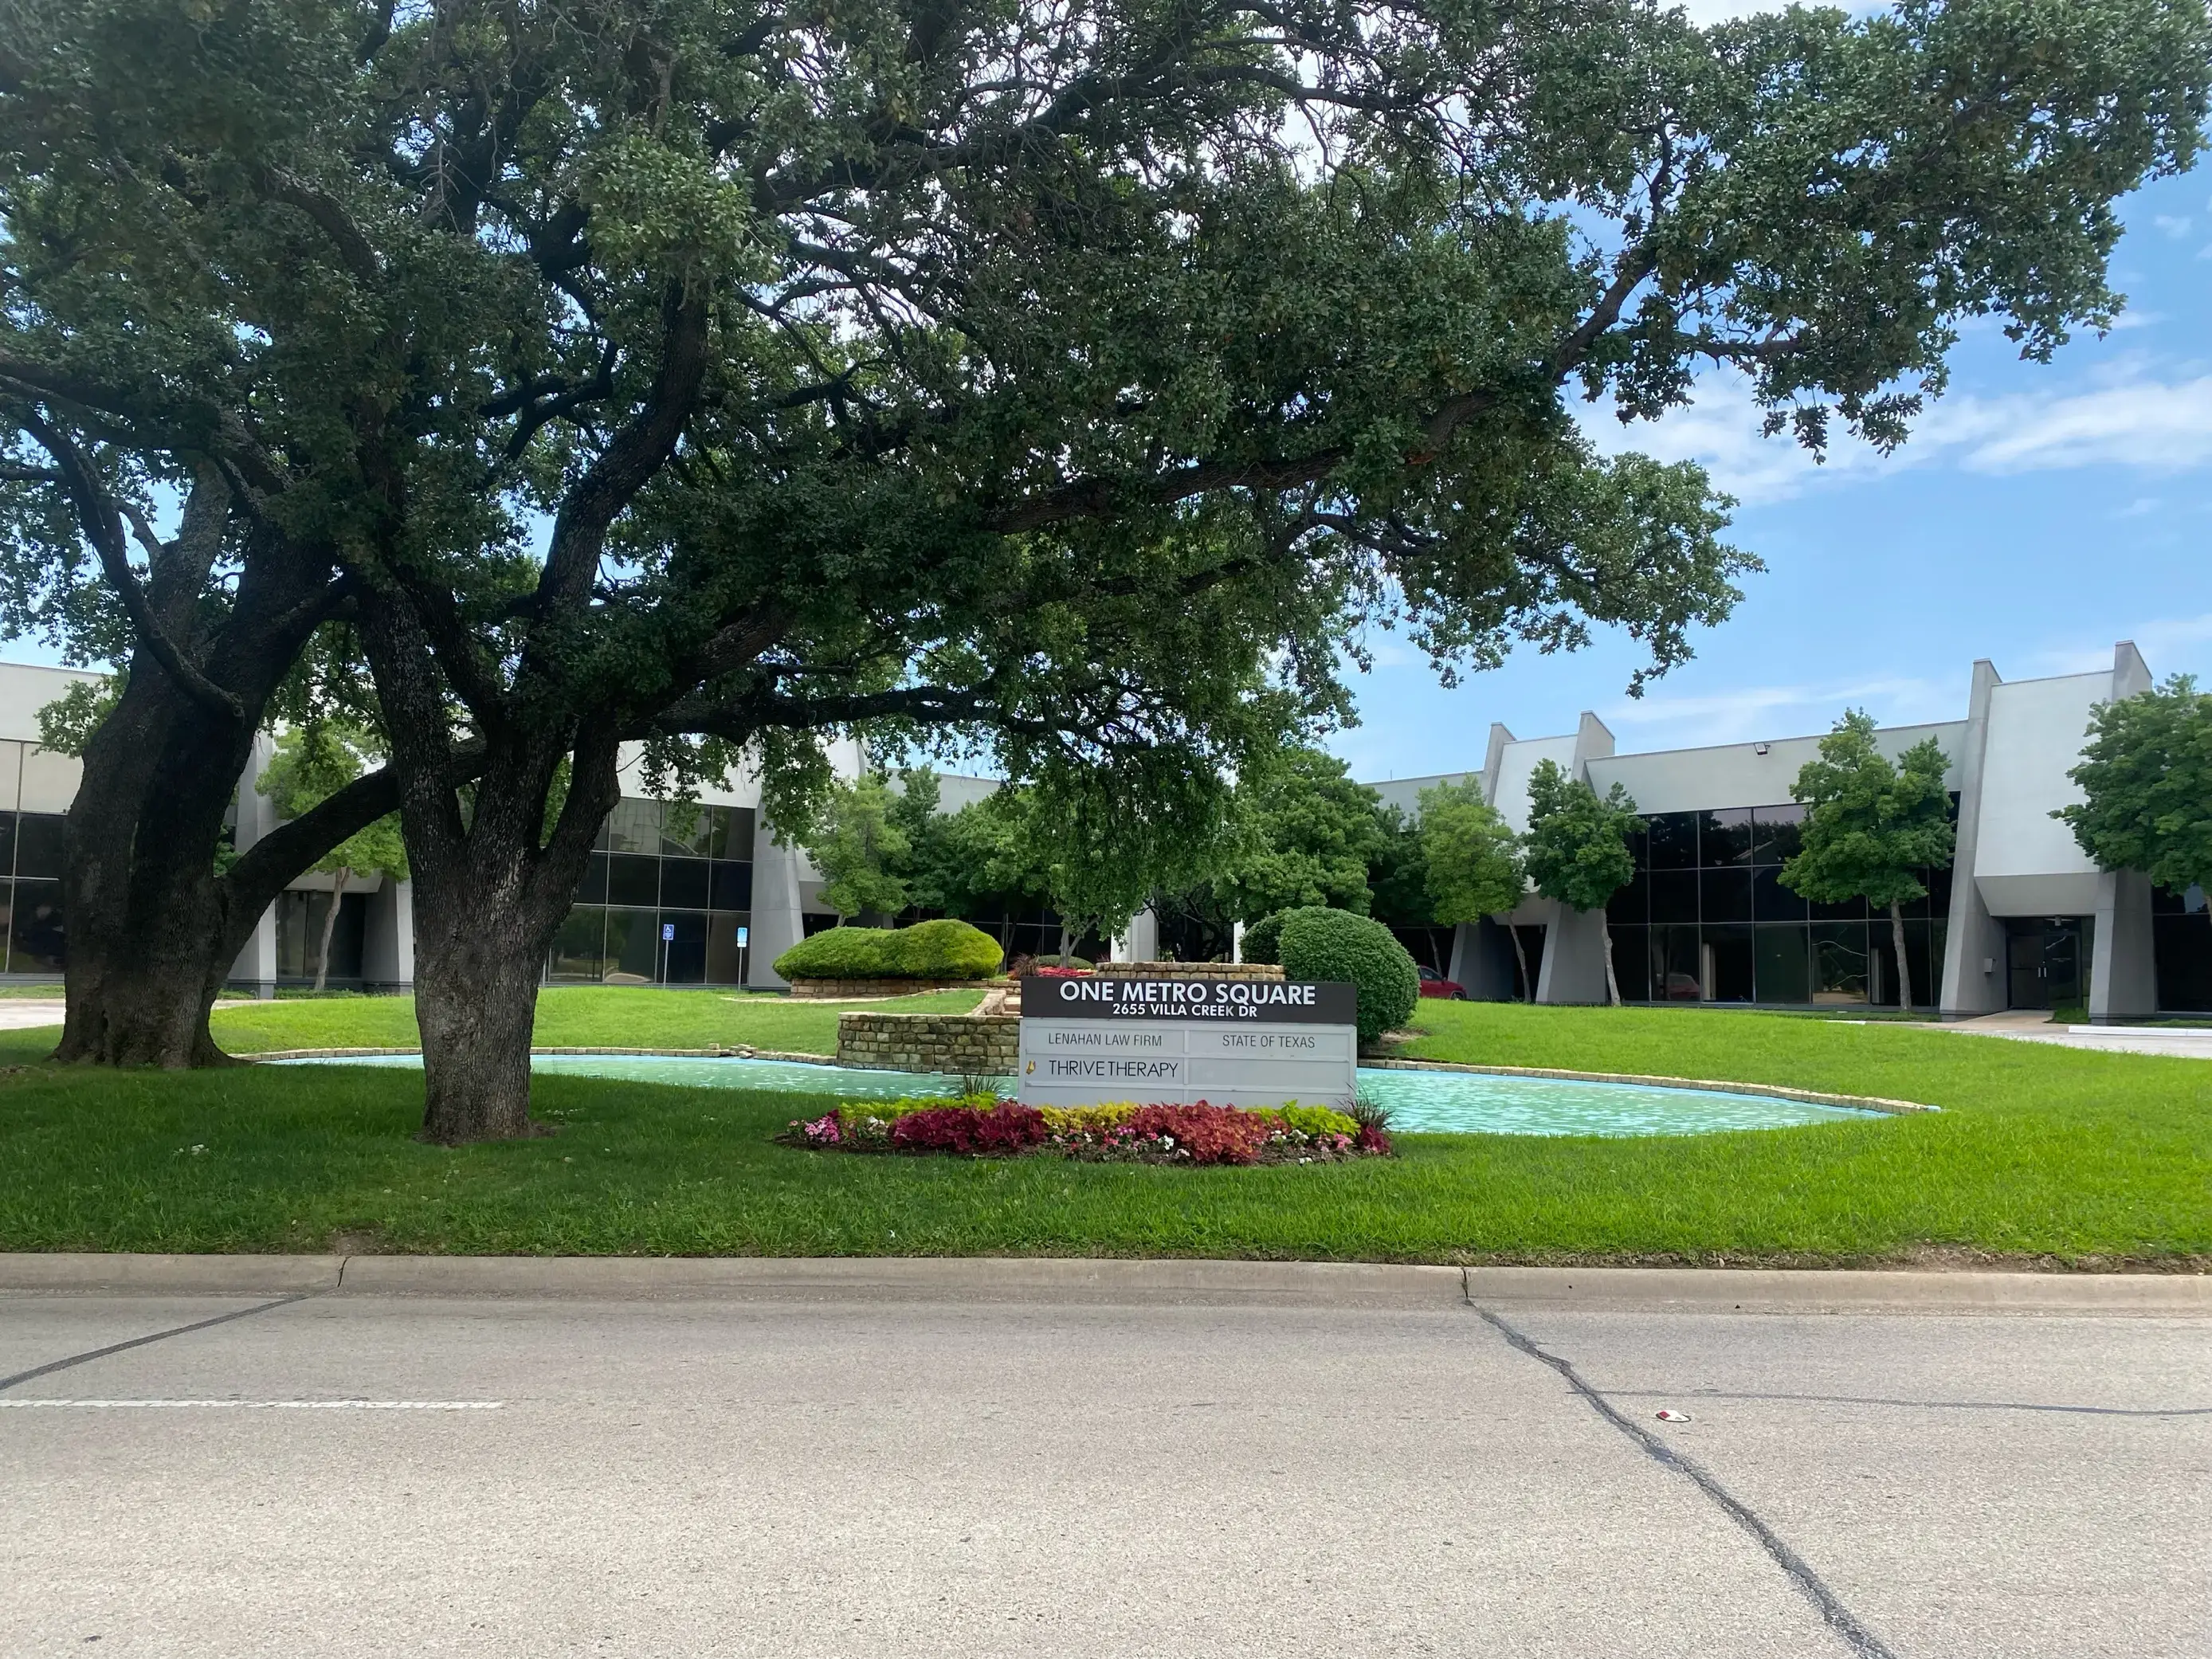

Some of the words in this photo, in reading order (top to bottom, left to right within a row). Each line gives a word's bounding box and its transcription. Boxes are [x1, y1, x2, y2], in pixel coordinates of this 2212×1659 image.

[1060, 981, 1114, 1002] ONE
[1122, 982, 1207, 1004] METRO
[1215, 983, 1316, 1006] SQUARE
[1112, 1003, 1146, 1016] 2655
[1150, 1004, 1187, 1017] VILLA
[1191, 1004, 1234, 1018] CREEK
[1238, 1006, 1257, 1018] DR
[1048, 1033, 1101, 1046] LENAHAN
[1105, 1033, 1130, 1046] LAW
[1134, 1034, 1163, 1047] FIRM
[1222, 1034, 1257, 1048] STATE
[1260, 1035, 1275, 1048] OF
[1278, 1036, 1316, 1049] TEXAS
[1049, 1060, 1105, 1077] THRIVE
[1108, 1061, 1179, 1078] THERAPY
